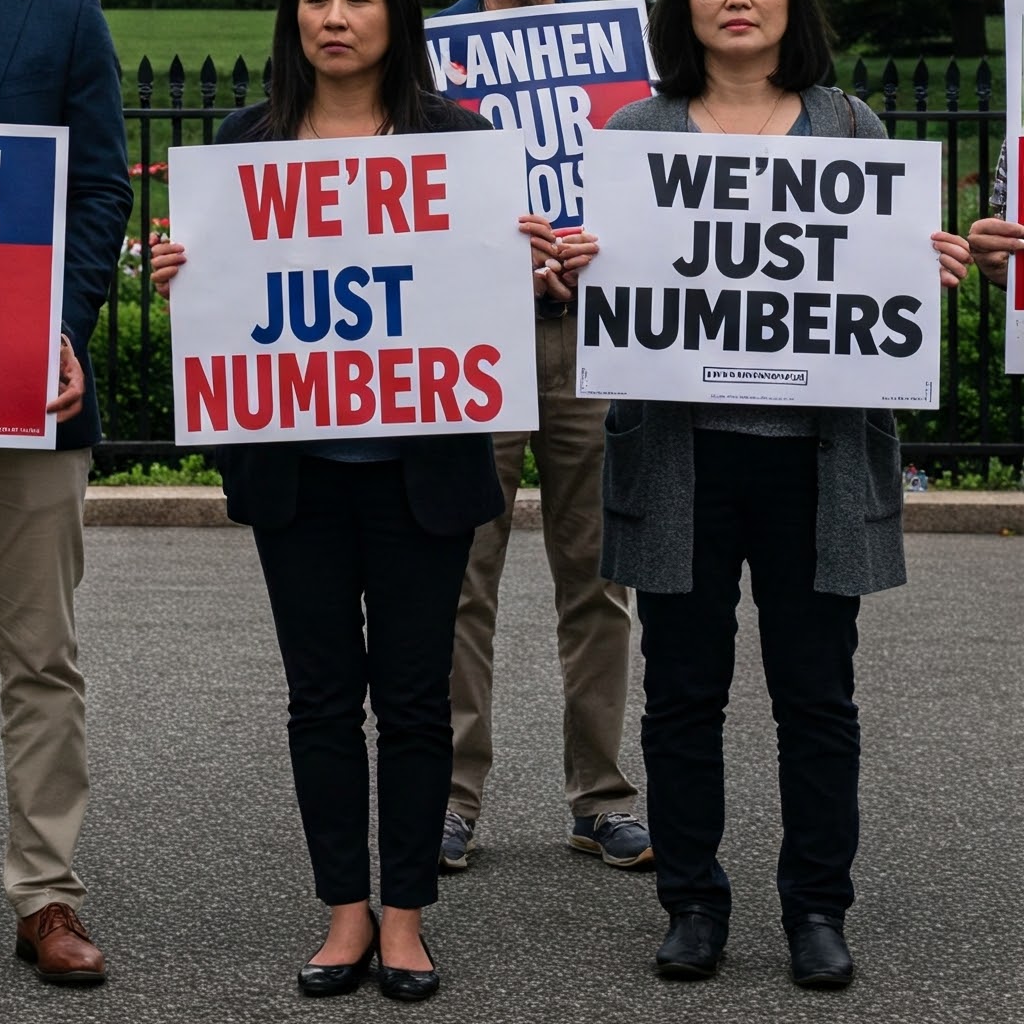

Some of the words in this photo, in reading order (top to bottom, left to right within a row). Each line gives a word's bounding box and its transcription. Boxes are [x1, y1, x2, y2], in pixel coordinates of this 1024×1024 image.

[238, 153, 450, 240] WE'RE
[647, 153, 905, 215] WE'NOT
[672, 221, 848, 282] JUST
[250, 265, 413, 345] JUST
[584, 286, 923, 358] NUMBERS
[184, 344, 503, 432] NUMBERS
